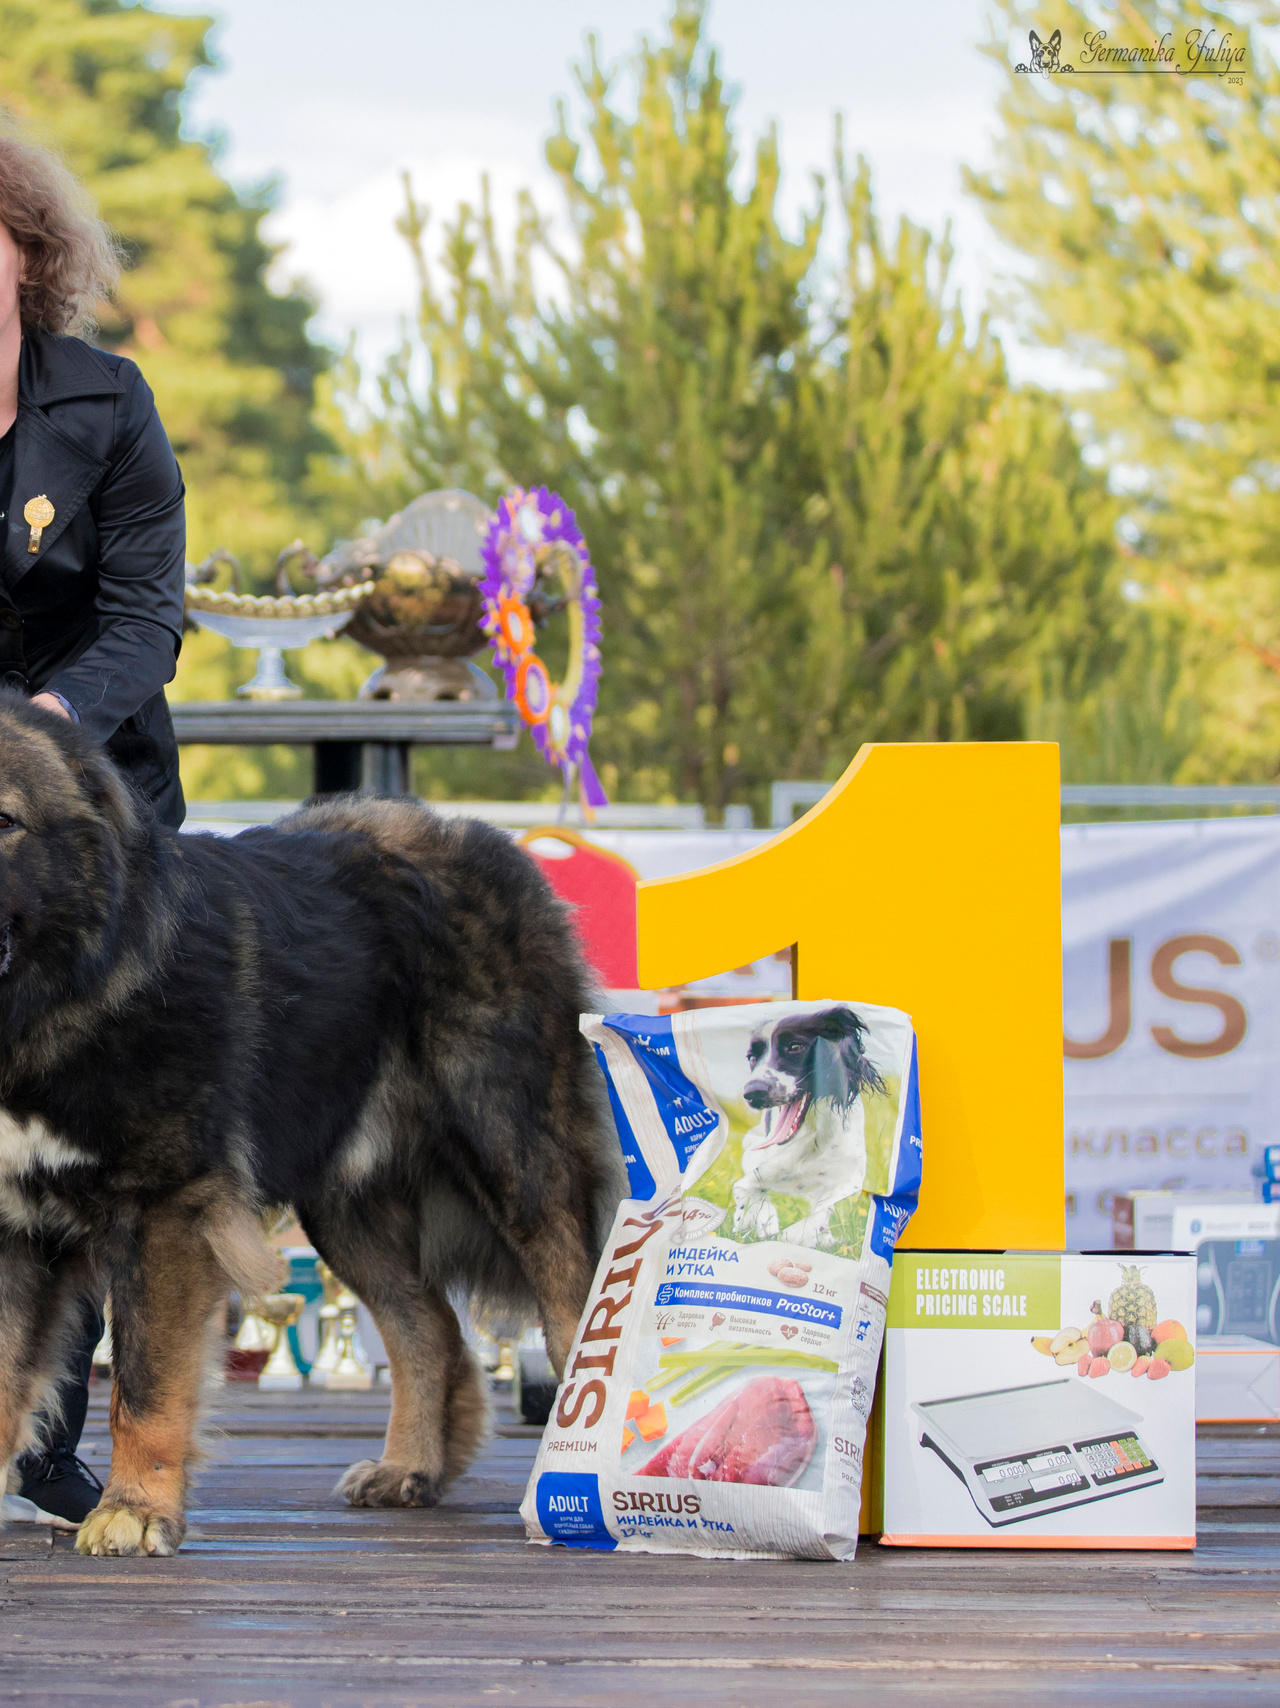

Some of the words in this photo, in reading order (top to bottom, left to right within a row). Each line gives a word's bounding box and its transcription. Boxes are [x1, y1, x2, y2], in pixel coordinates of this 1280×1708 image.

[674, 1107, 716, 1136] ADULT
[1071, 1126, 1248, 1156] класса
[668, 1246, 740, 1263] ИНДЕЙКА
[666, 1263, 674, 1276] И
[676, 1263, 715, 1277] УТКА
[916, 1268, 1005, 1291] ELECTRONIC
[812, 1282, 823, 1294] 12
[824, 1288, 838, 1298] кг
[674, 1286, 715, 1300] Комплекс
[715, 1290, 773, 1308] пробиотиков
[776, 1297, 836, 1322] ProStor+
[916, 1294, 977, 1316] PRICING
[982, 1294, 1027, 1316] SCALE
[677, 1311, 705, 1321] Здоровая
[729, 1315, 757, 1325] Высокая
[676, 1321, 697, 1329] шерсть
[728, 1325, 772, 1336] питательность
[802, 1326, 831, 1340] Здоровое
[800, 1335, 822, 1347] сердце
[547, 1440, 597, 1453] PREMIUM
[1047, 1454, 1068, 1467] 0.00
[999, 1465, 1025, 1478] 0.000
[1058, 1473, 1079, 1485] 0.00
[549, 1495, 589, 1512] ADULT
[612, 1490, 701, 1514] SIRIUS
[616, 1514, 685, 1528] ИНДЕЙКА
[688, 1518, 697, 1529] И
[701, 1518, 735, 1533] УТКА
